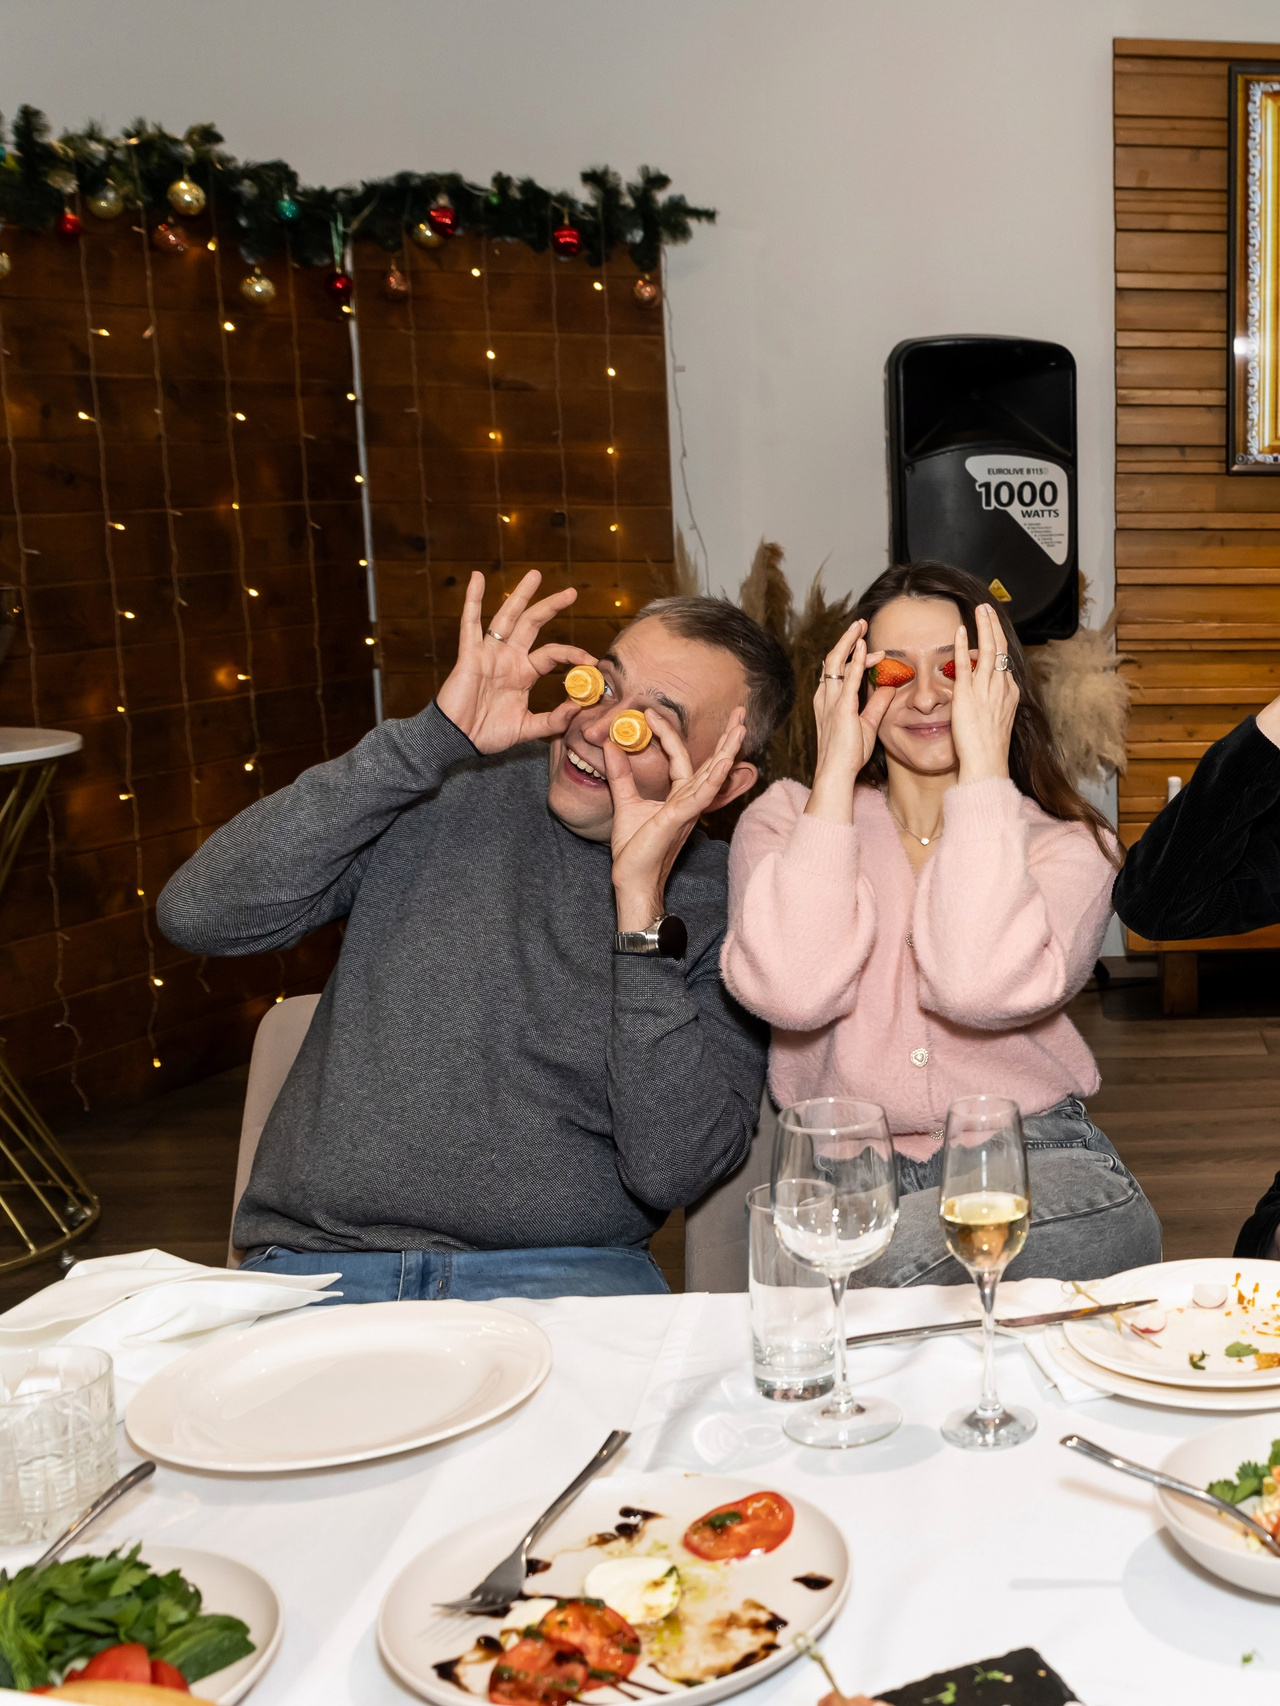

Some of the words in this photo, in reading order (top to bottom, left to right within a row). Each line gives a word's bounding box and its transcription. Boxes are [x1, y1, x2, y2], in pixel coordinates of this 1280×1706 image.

[987, 467, 1025, 476] EUROLIVE
[976, 480, 1058, 508] 1000
[1021, 509, 1060, 518] WATTS
